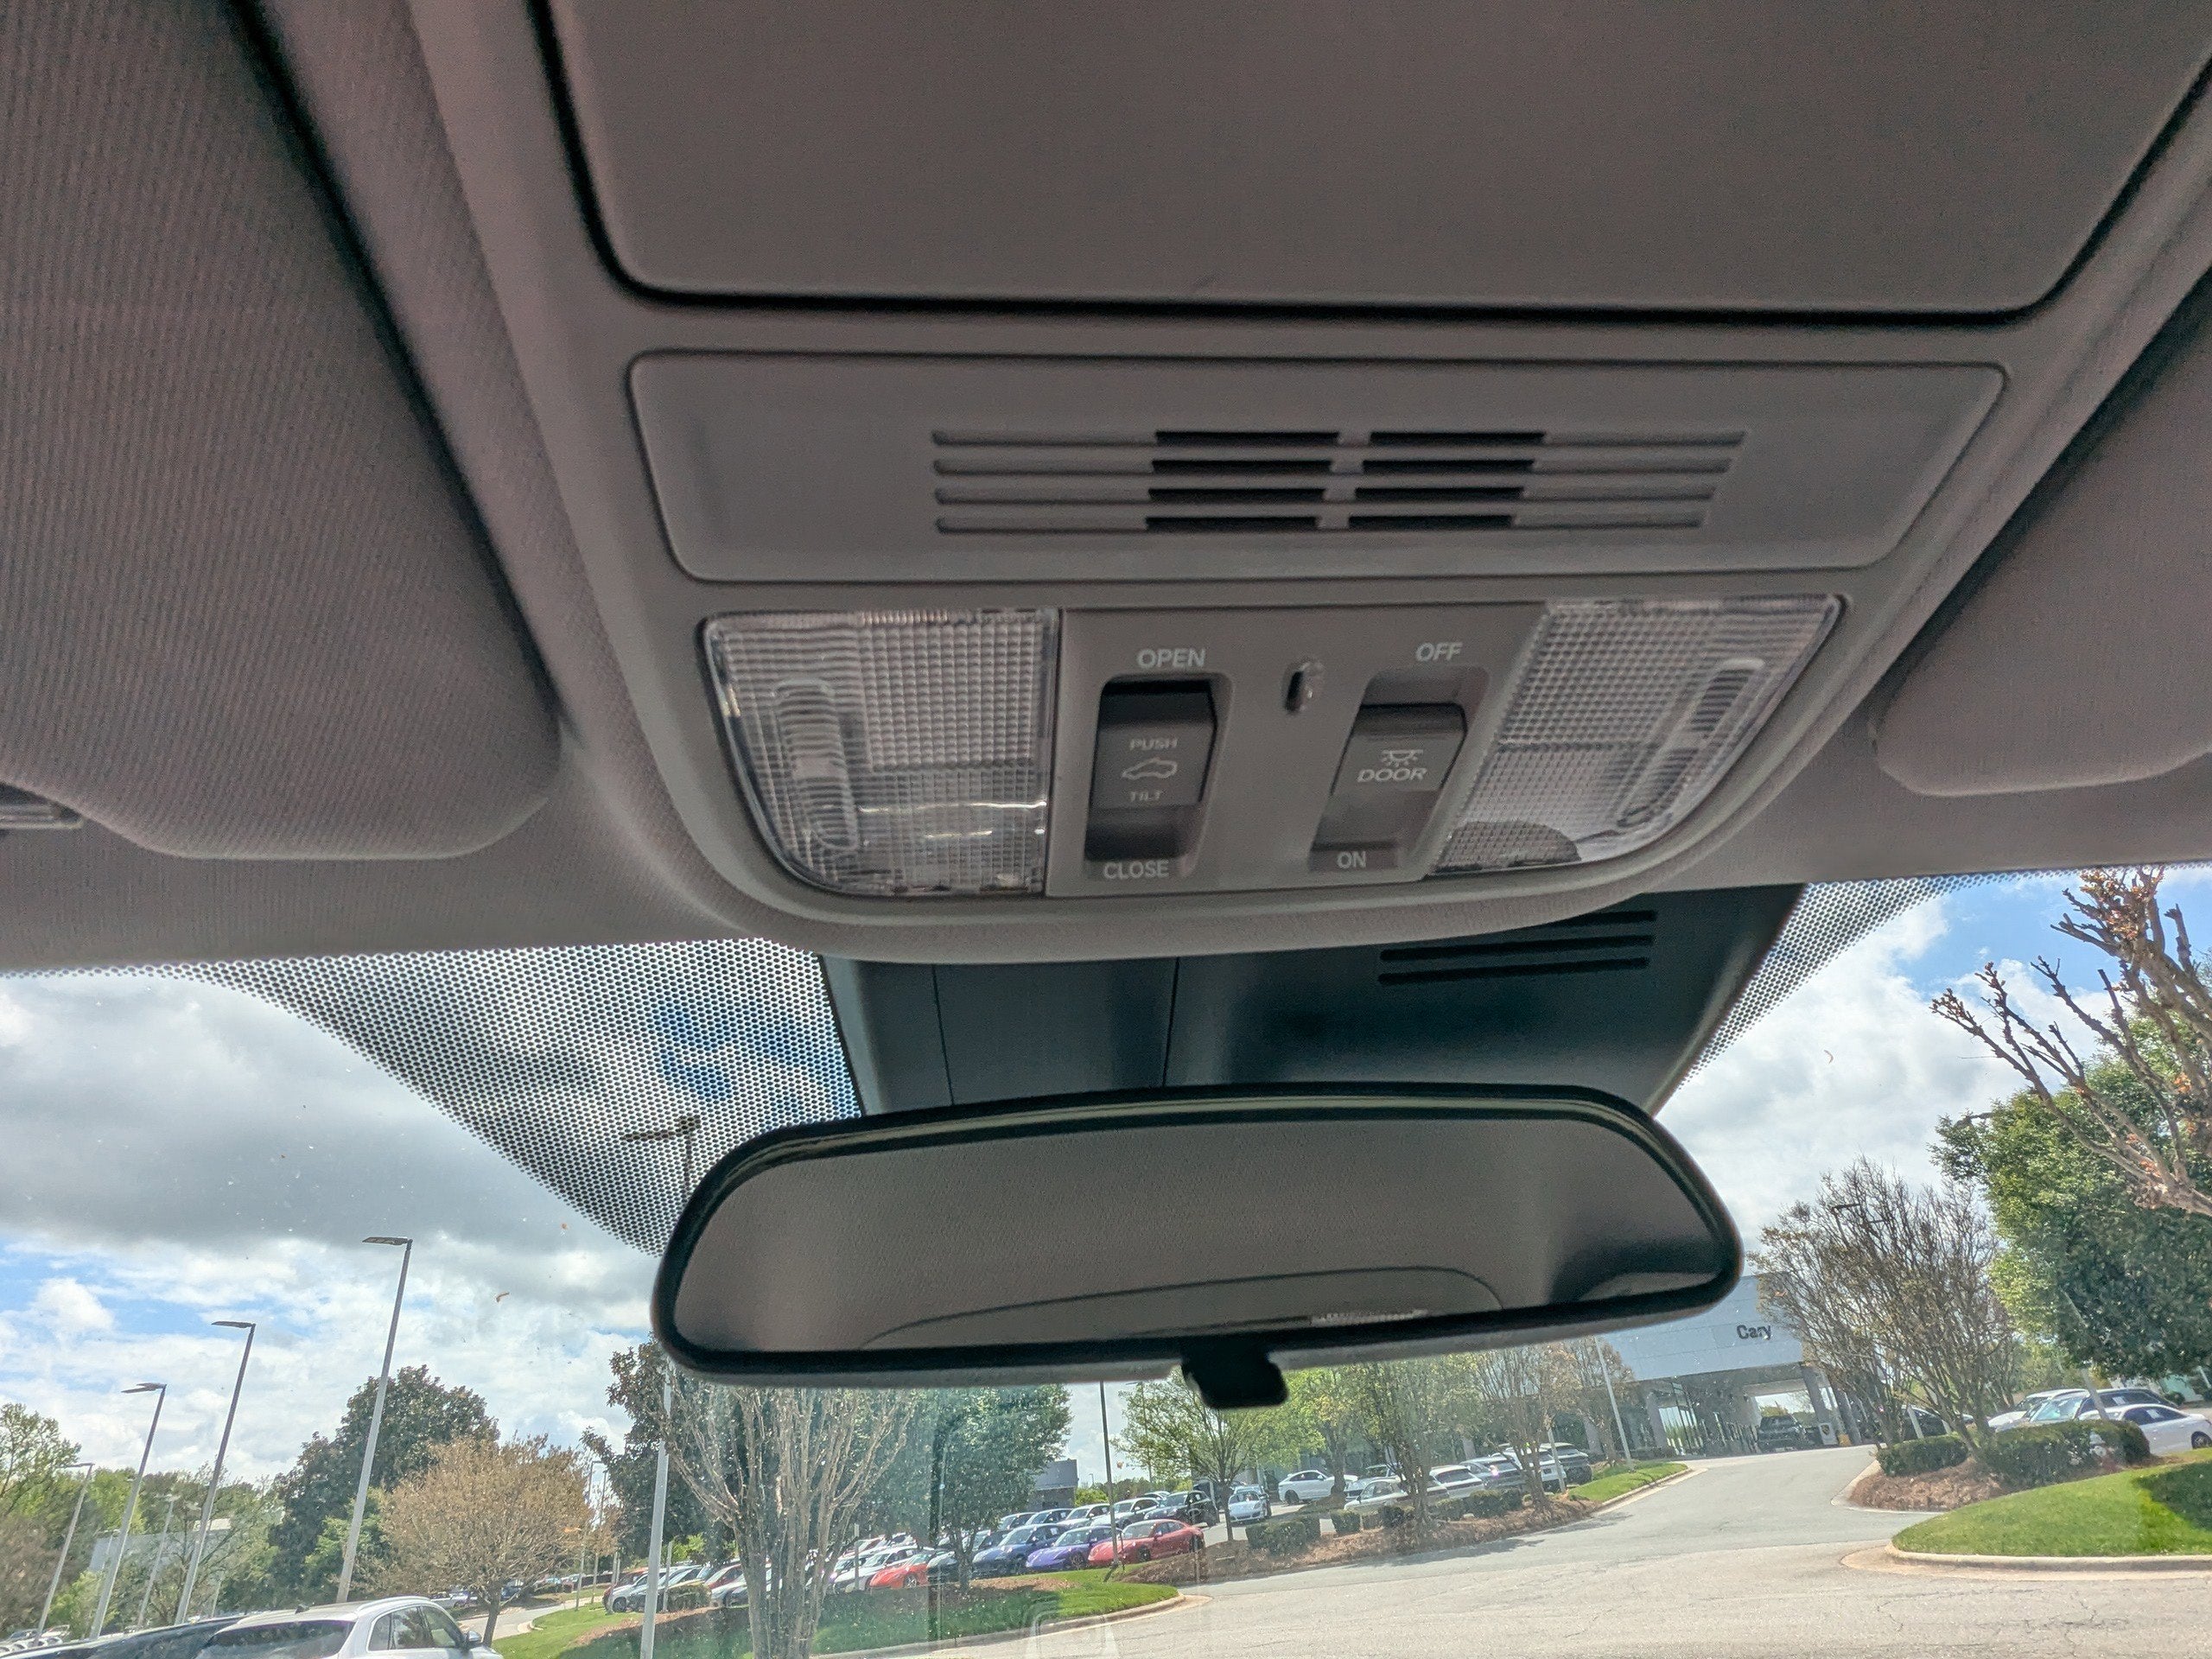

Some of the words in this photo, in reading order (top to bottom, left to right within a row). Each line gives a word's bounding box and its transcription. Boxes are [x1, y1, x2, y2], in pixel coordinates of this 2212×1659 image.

[1136, 648, 1206, 669] OPEN
[1414, 641, 1463, 662] OFF
[1128, 736, 1179, 751] PUSH
[1357, 767, 1427, 783] DOOR
[1129, 789, 1163, 803] TILT
[1337, 850, 1367, 868] ON
[1103, 859, 1169, 880] CLOSE
[1736, 1324, 1771, 1341] Cary
